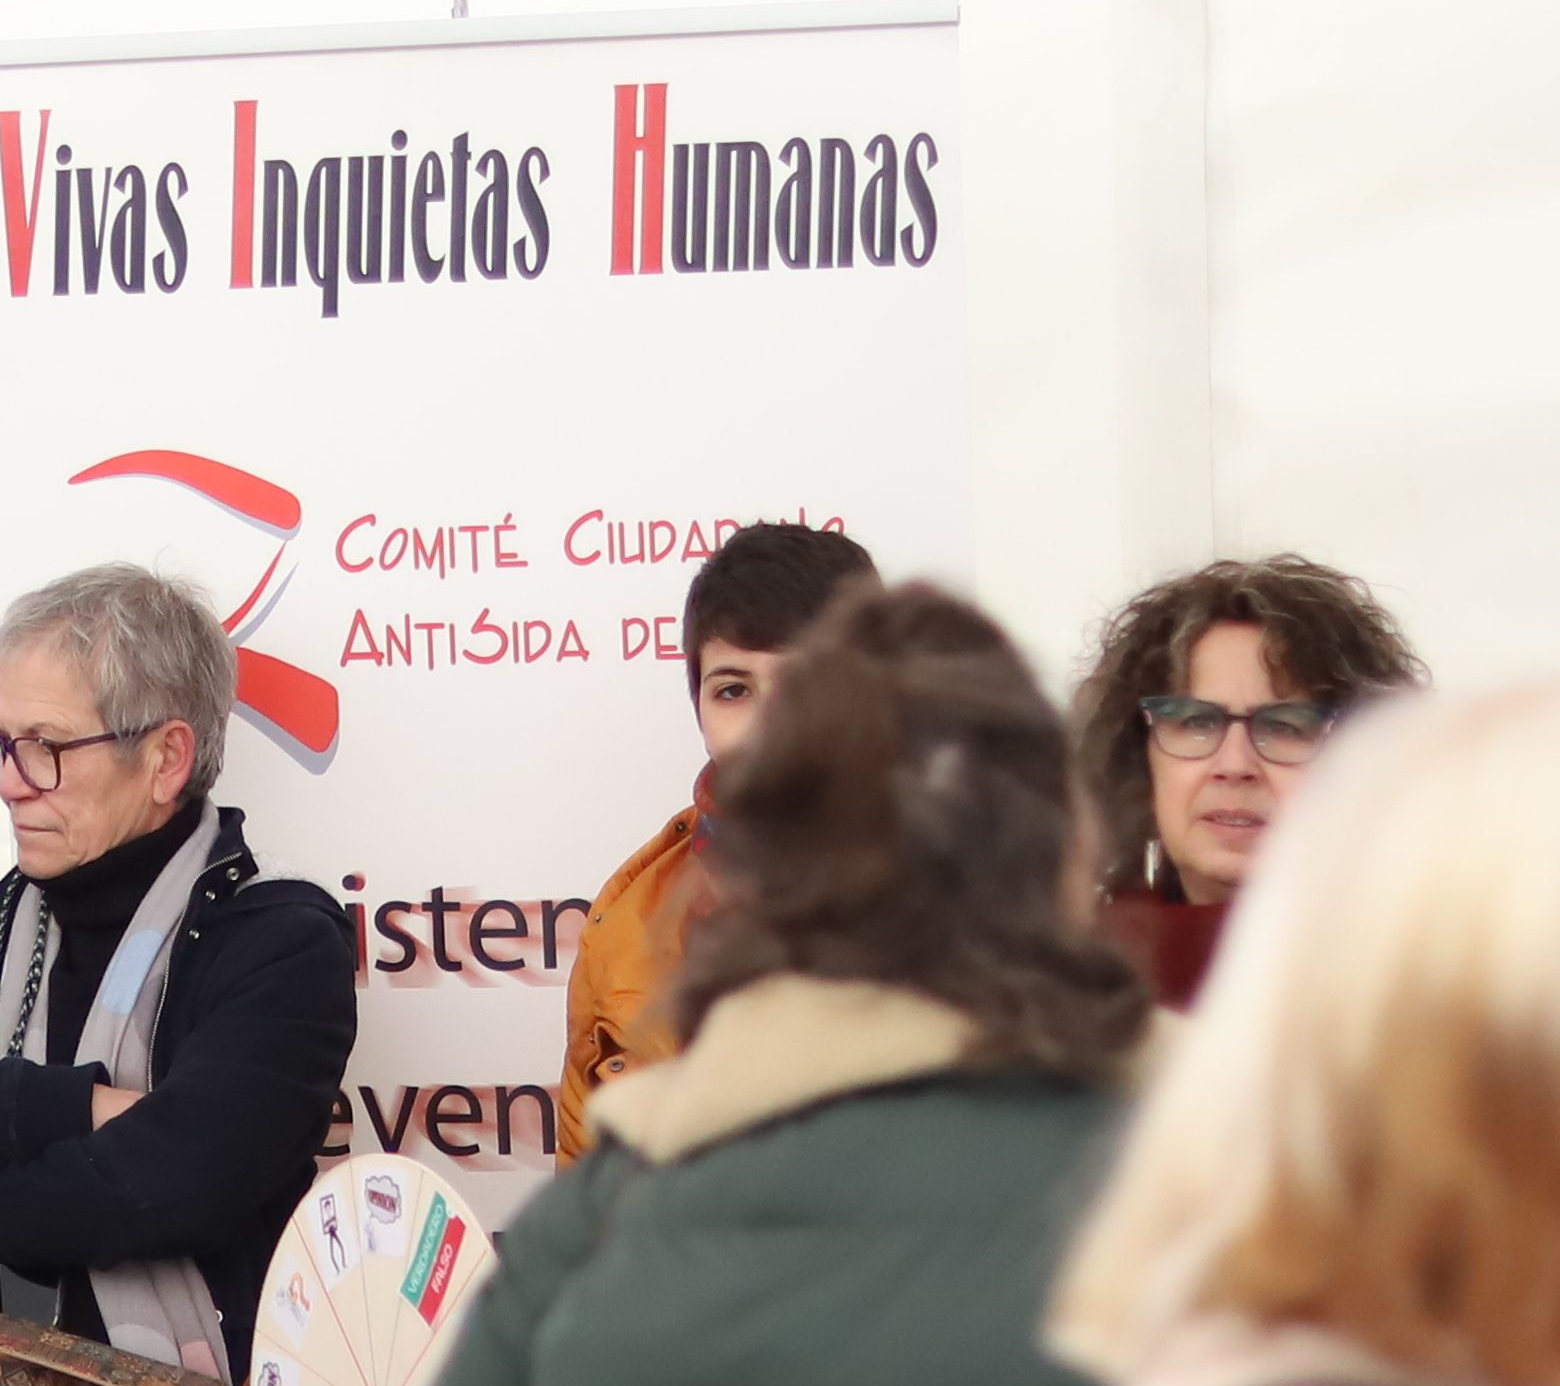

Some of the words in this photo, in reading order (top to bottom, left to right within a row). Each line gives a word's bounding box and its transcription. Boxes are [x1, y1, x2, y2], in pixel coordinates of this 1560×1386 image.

[229, 99, 550, 318] Inquietas
[609, 82, 939, 275] Humanas
[407, 1202, 447, 1297] VERDADERO
[432, 1243, 453, 1294] FALSO
